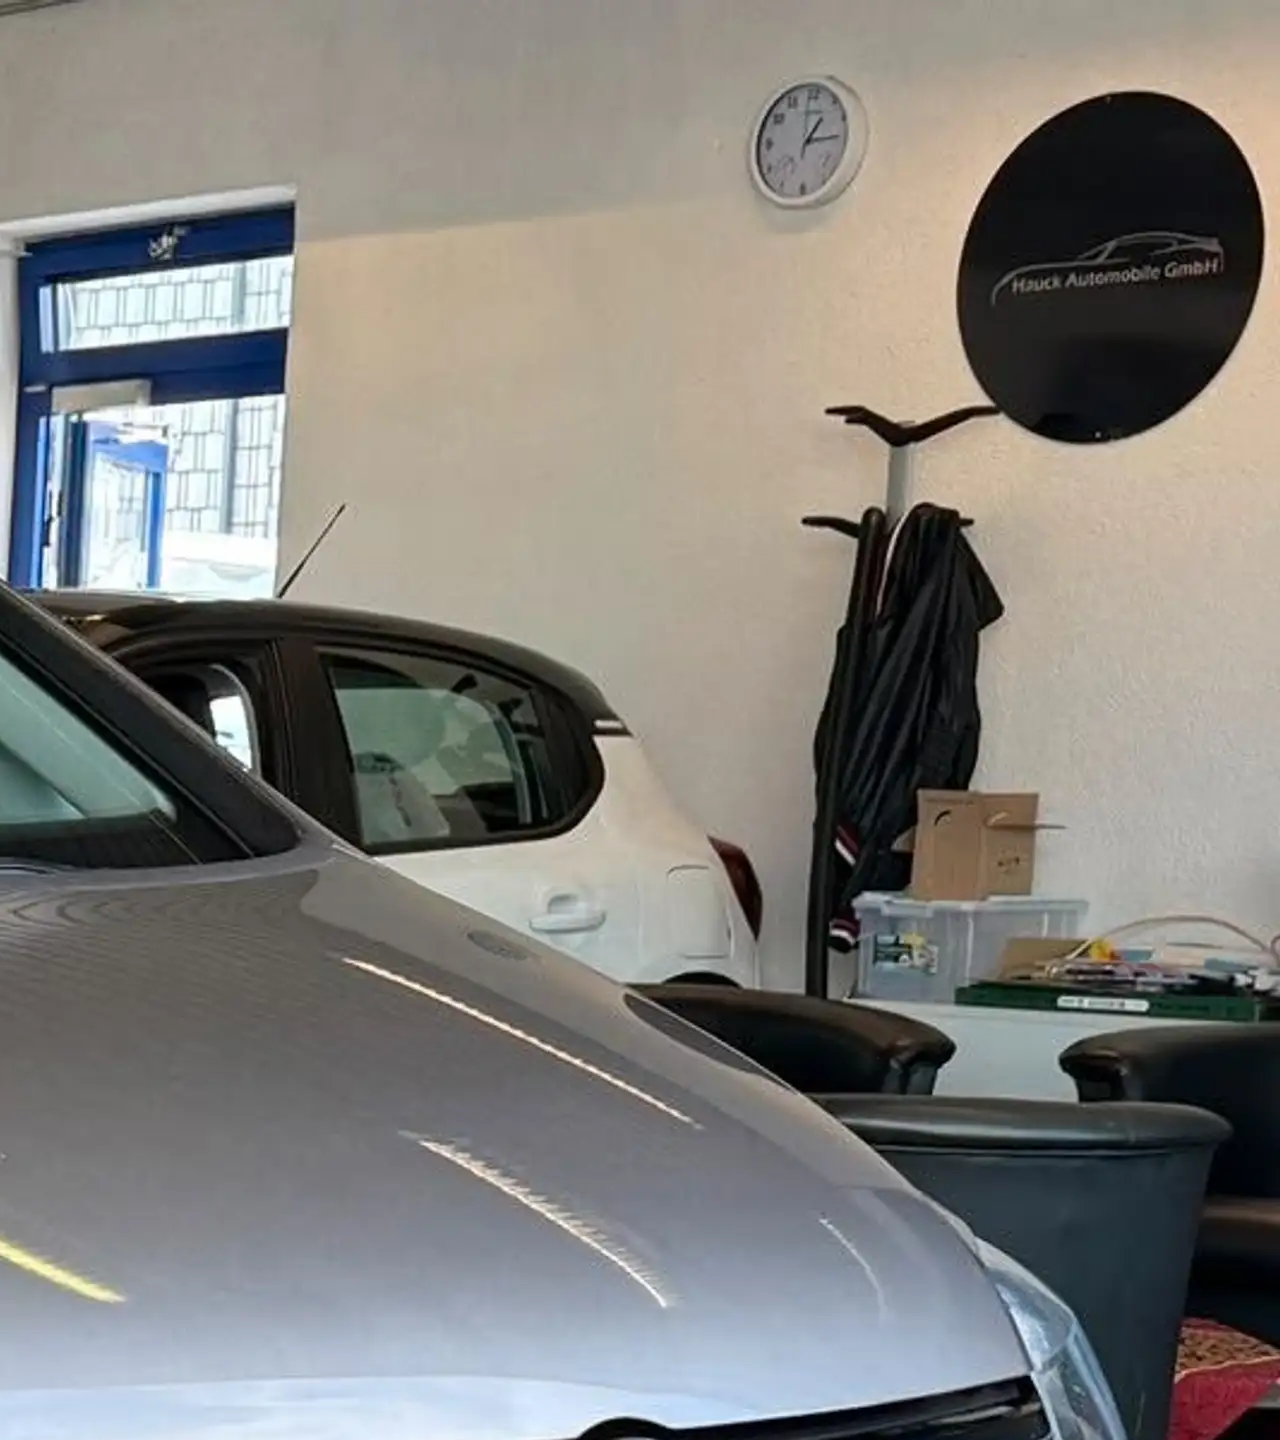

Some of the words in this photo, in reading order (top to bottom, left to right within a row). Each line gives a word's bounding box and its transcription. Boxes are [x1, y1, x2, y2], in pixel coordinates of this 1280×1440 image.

[1011, 276, 1063, 294] Hauck
[1065, 265, 1160, 288] Automobile
[1164, 258, 1218, 278] GmbH
